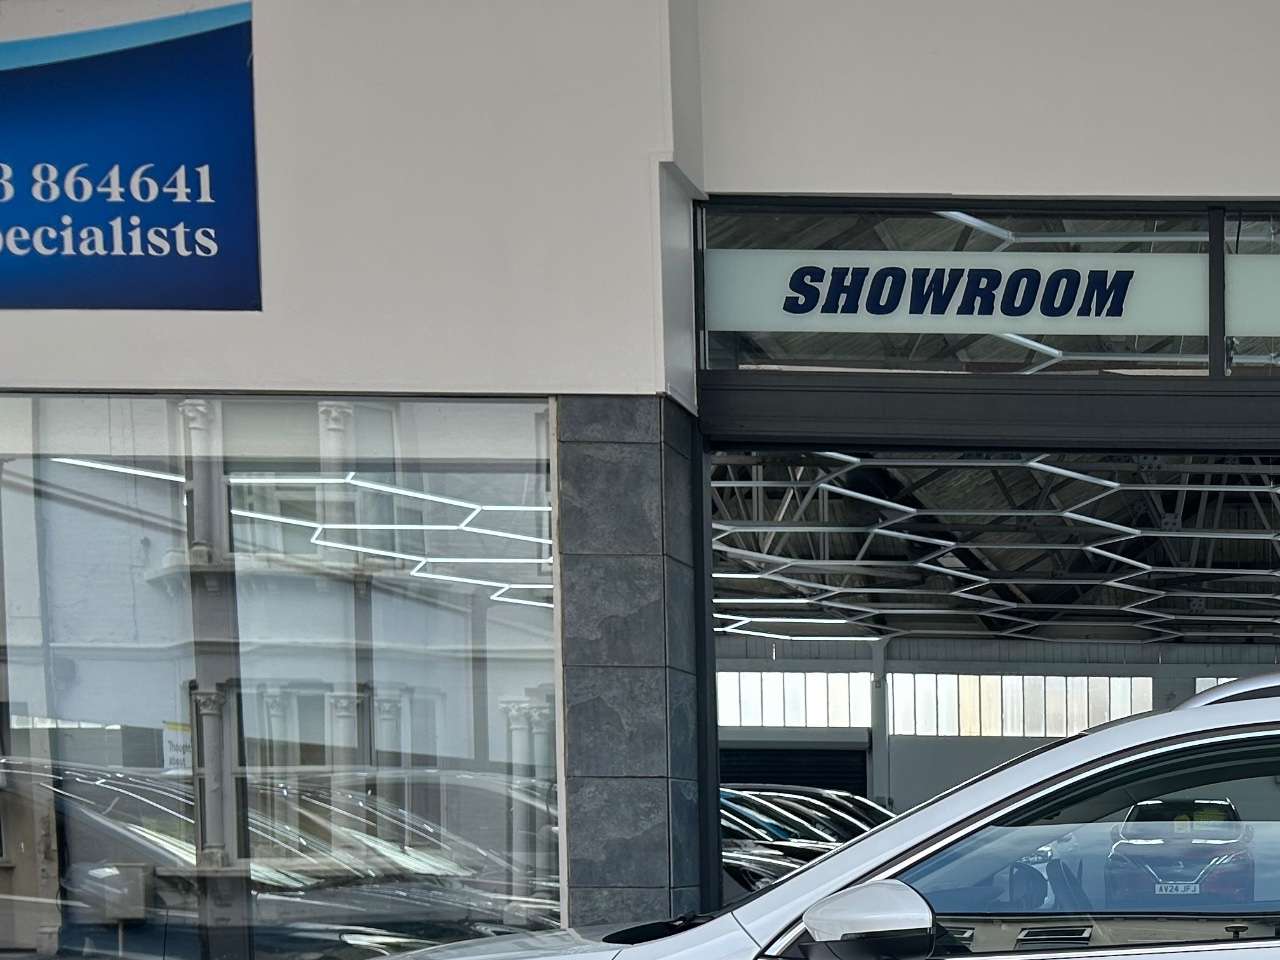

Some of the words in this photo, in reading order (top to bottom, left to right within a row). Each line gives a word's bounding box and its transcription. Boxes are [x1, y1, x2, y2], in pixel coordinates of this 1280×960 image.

[31, 162, 216, 203] 864641
[0, 214, 219, 257] ecialists
[782, 265, 1135, 318] SHOWROOM
